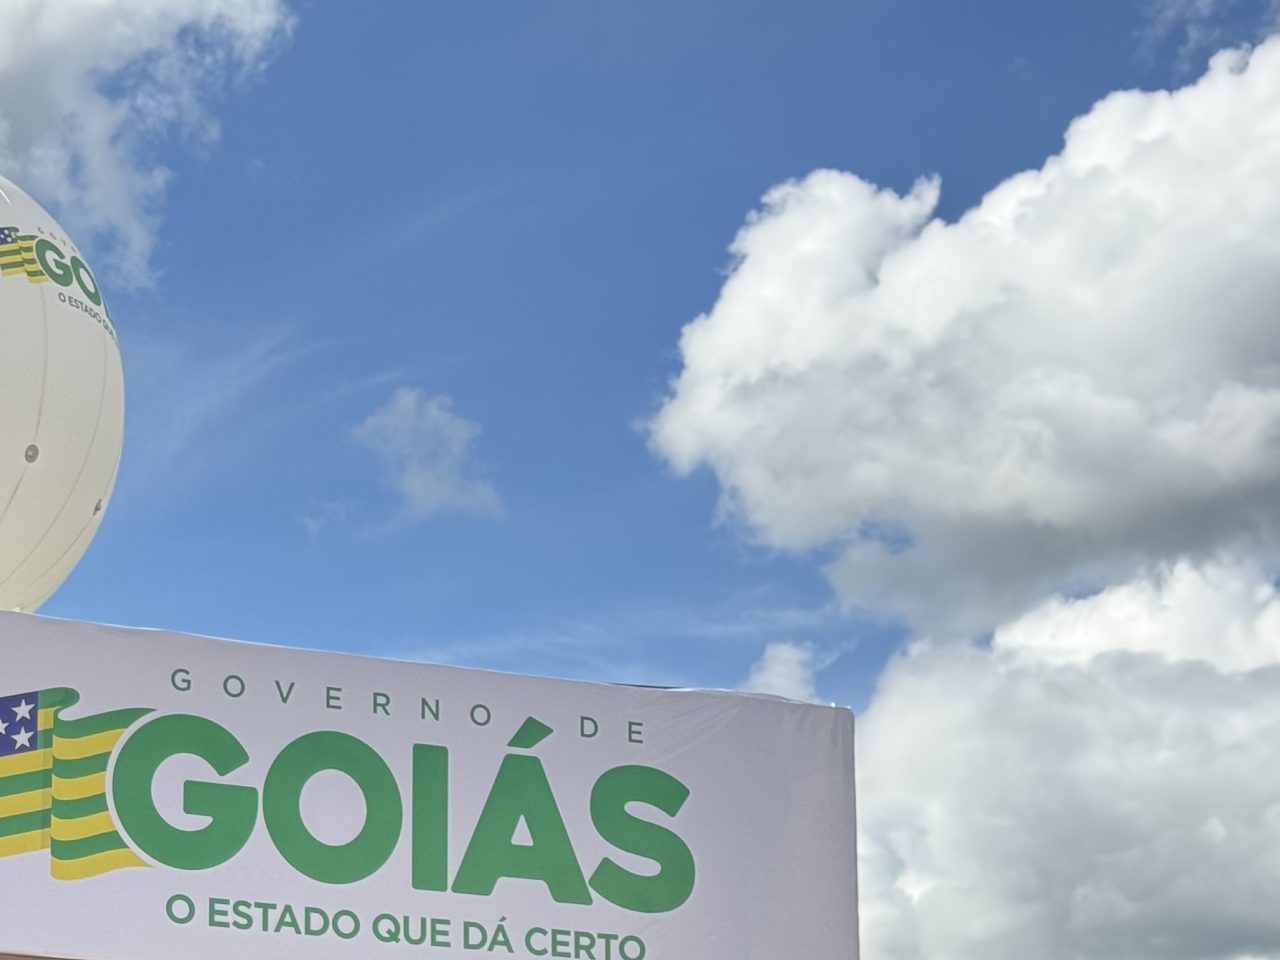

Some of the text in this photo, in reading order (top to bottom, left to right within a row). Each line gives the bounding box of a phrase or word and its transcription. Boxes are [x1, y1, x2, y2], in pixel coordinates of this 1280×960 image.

[35, 238, 108, 318] GO
[58, 292, 66, 303] O
[170, 667, 644, 745] GOVERNO DE
[112, 713, 696, 914] GOIÁS
[165, 893, 196, 925] O
[208, 898, 361, 939] ESTADO
[371, 913, 451, 949] QUE
[462, 915, 514, 955] DÁ
